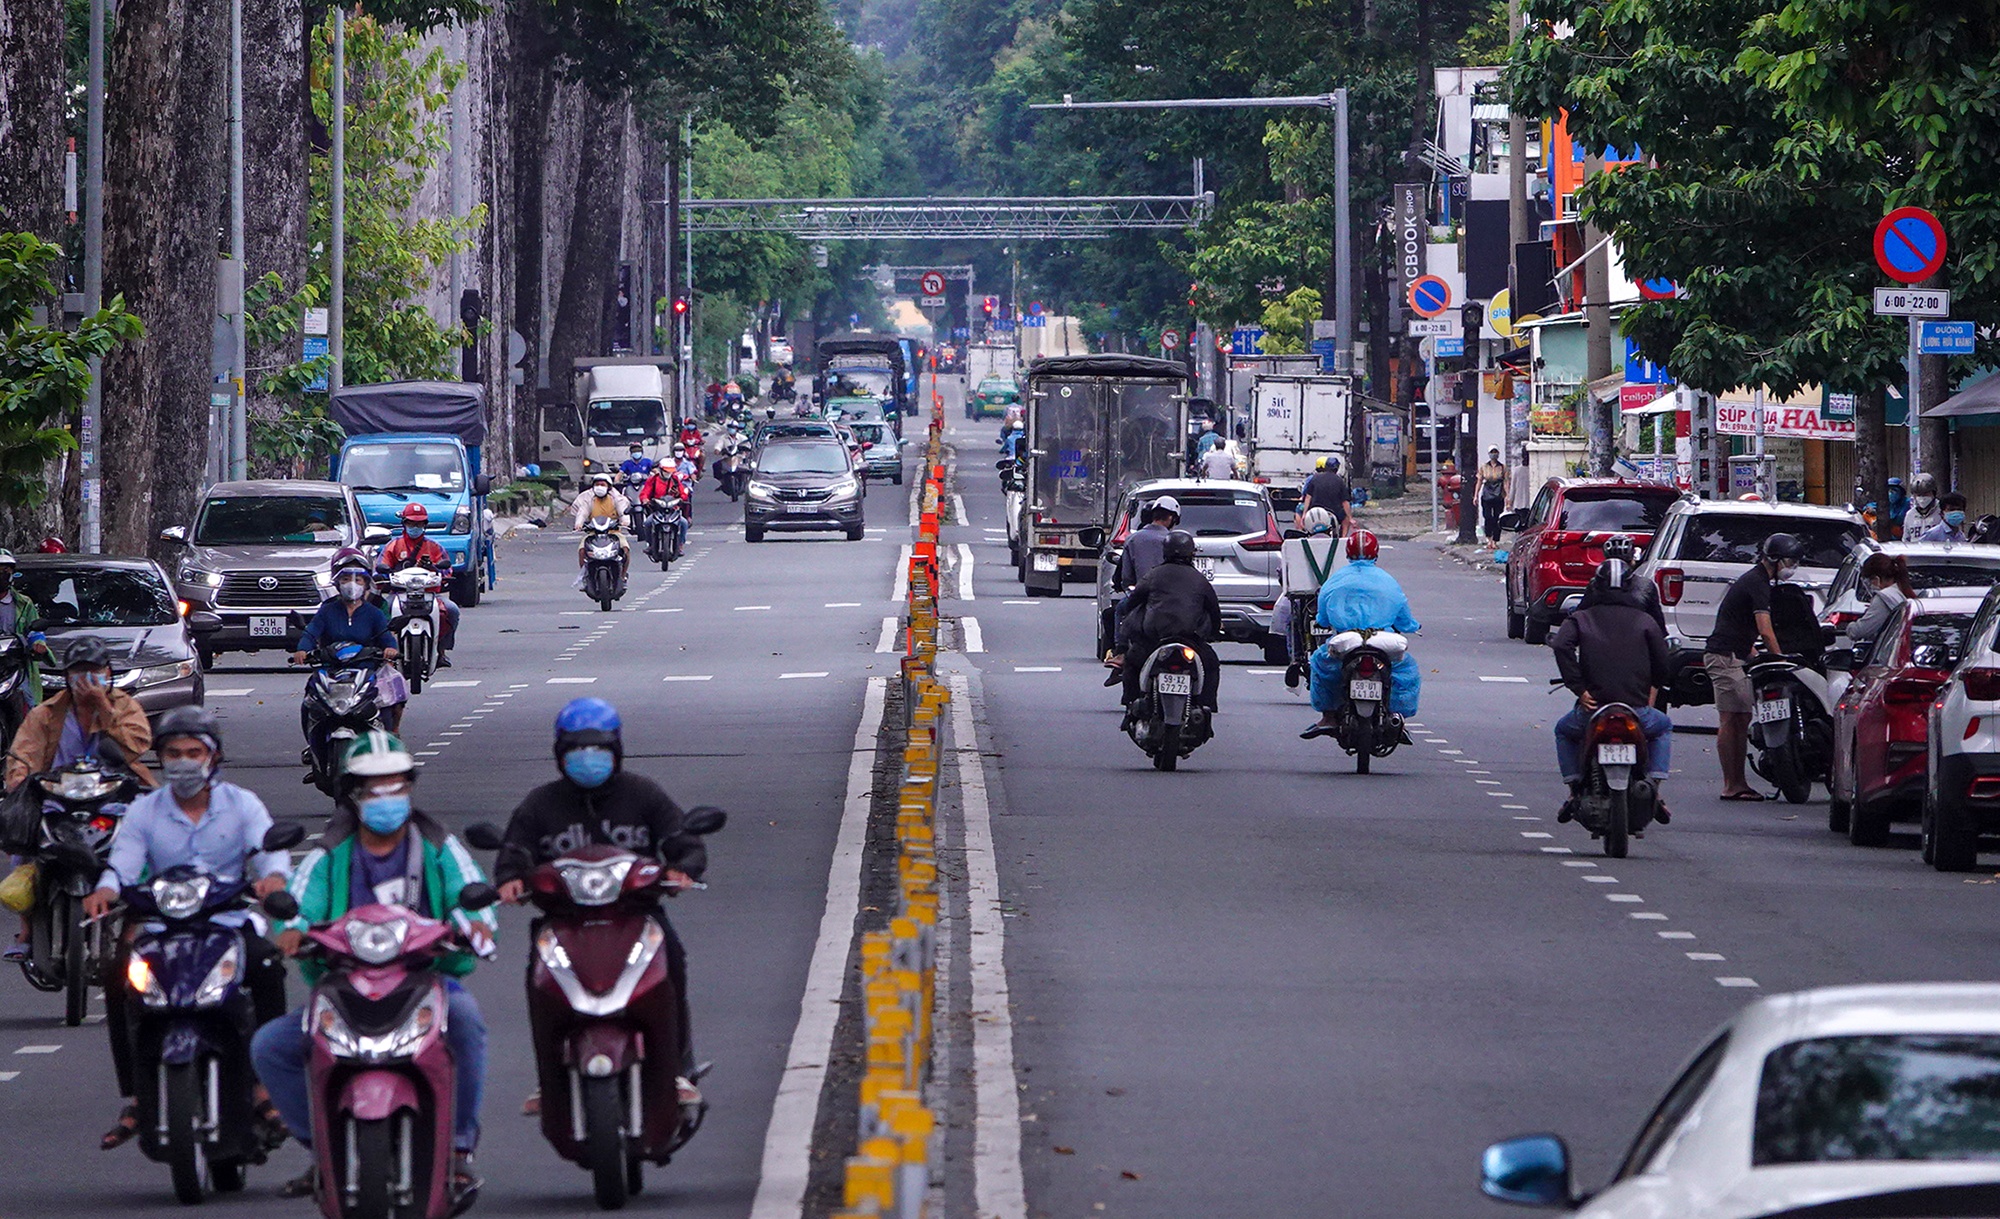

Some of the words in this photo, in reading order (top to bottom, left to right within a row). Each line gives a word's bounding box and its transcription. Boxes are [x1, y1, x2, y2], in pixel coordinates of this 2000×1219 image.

[1406, 189, 1414, 214] SHOP
[1405, 216, 1419, 304] ACBOOK
[1718, 405, 1747, 423] SÚP
[253, 626, 283, 635] 959.06
[259, 618, 276, 627] 51H
